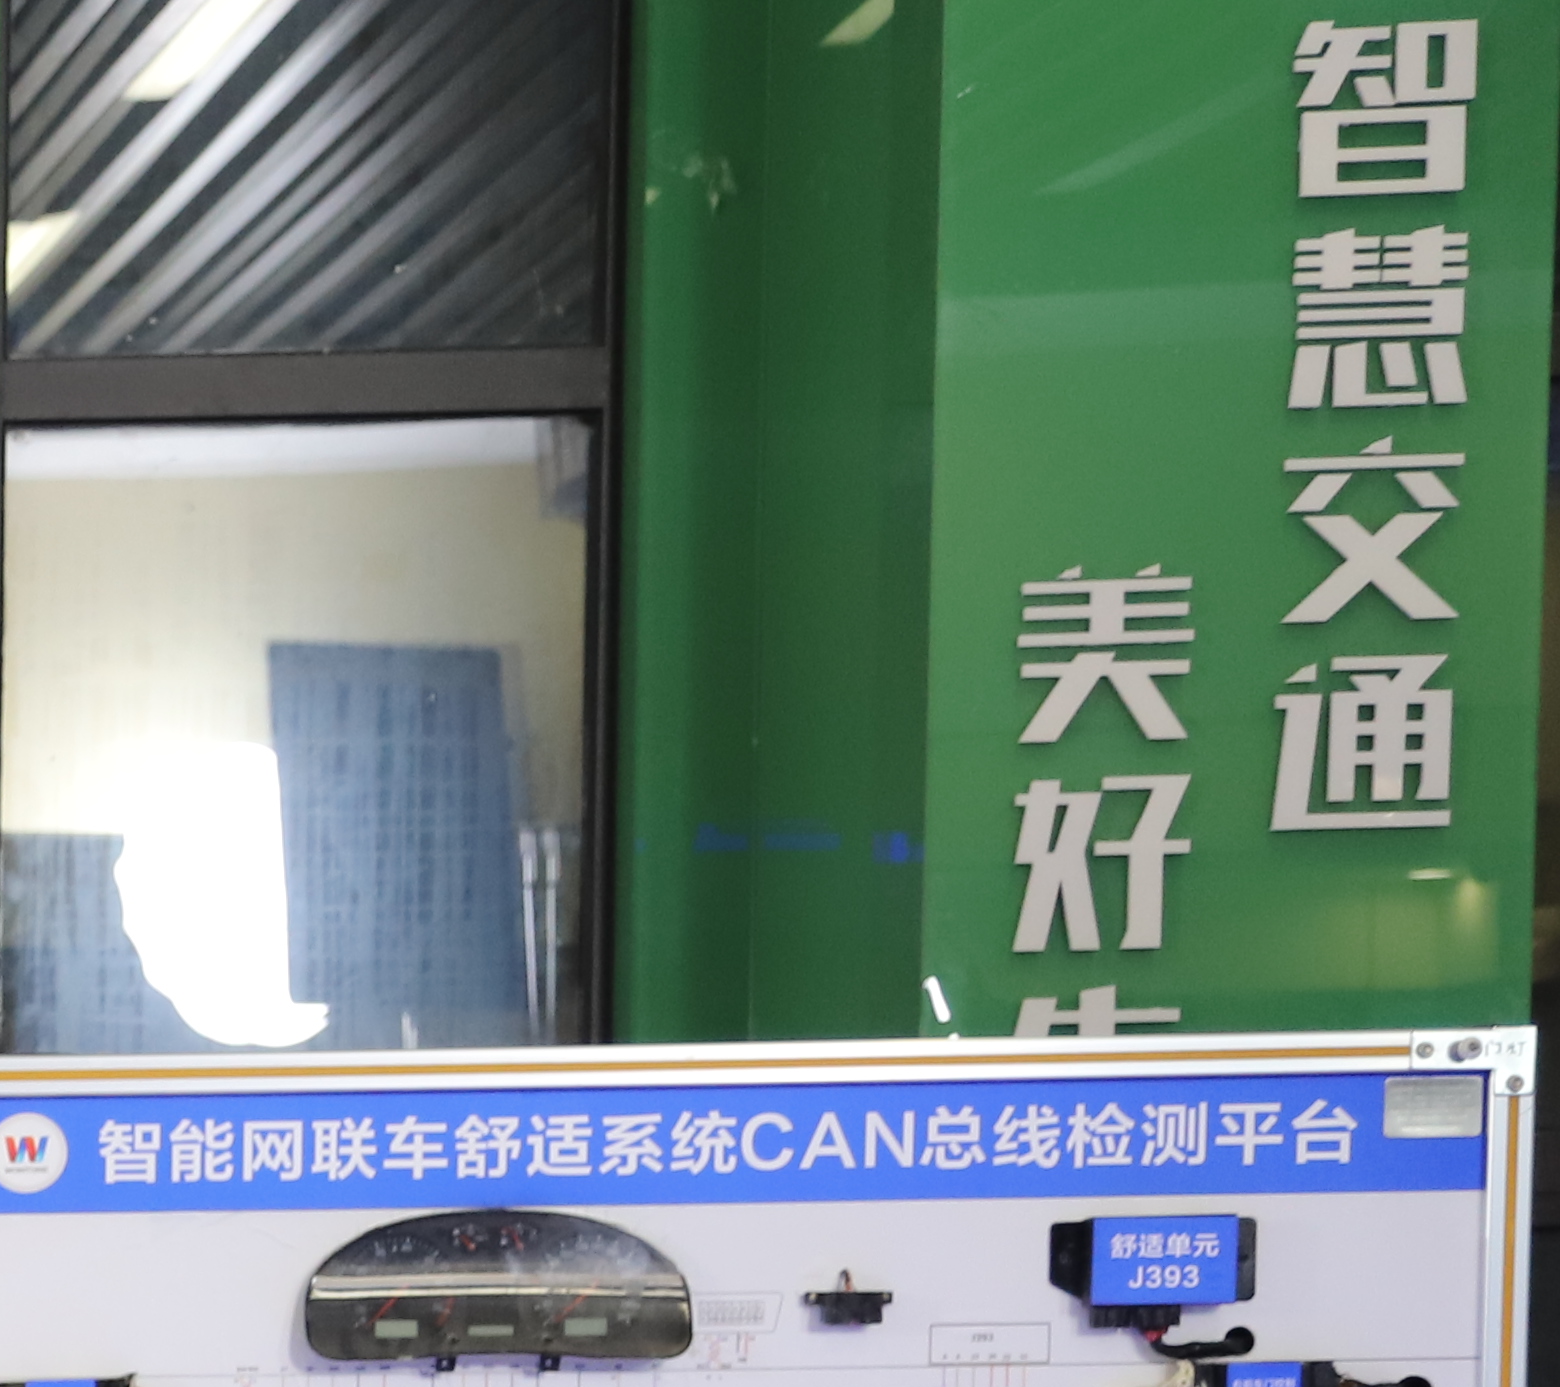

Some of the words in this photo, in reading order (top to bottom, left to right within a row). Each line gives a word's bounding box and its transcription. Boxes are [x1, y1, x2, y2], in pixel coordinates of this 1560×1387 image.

[1271, 20, 1478, 832] 智慧交通
[98, 1099, 1359, 1185] 智能网联车舒适系统CAN总线检测平台
[1110, 1232, 1220, 1259] 舒适单元
[1128, 1265, 1200, 1289] J393
